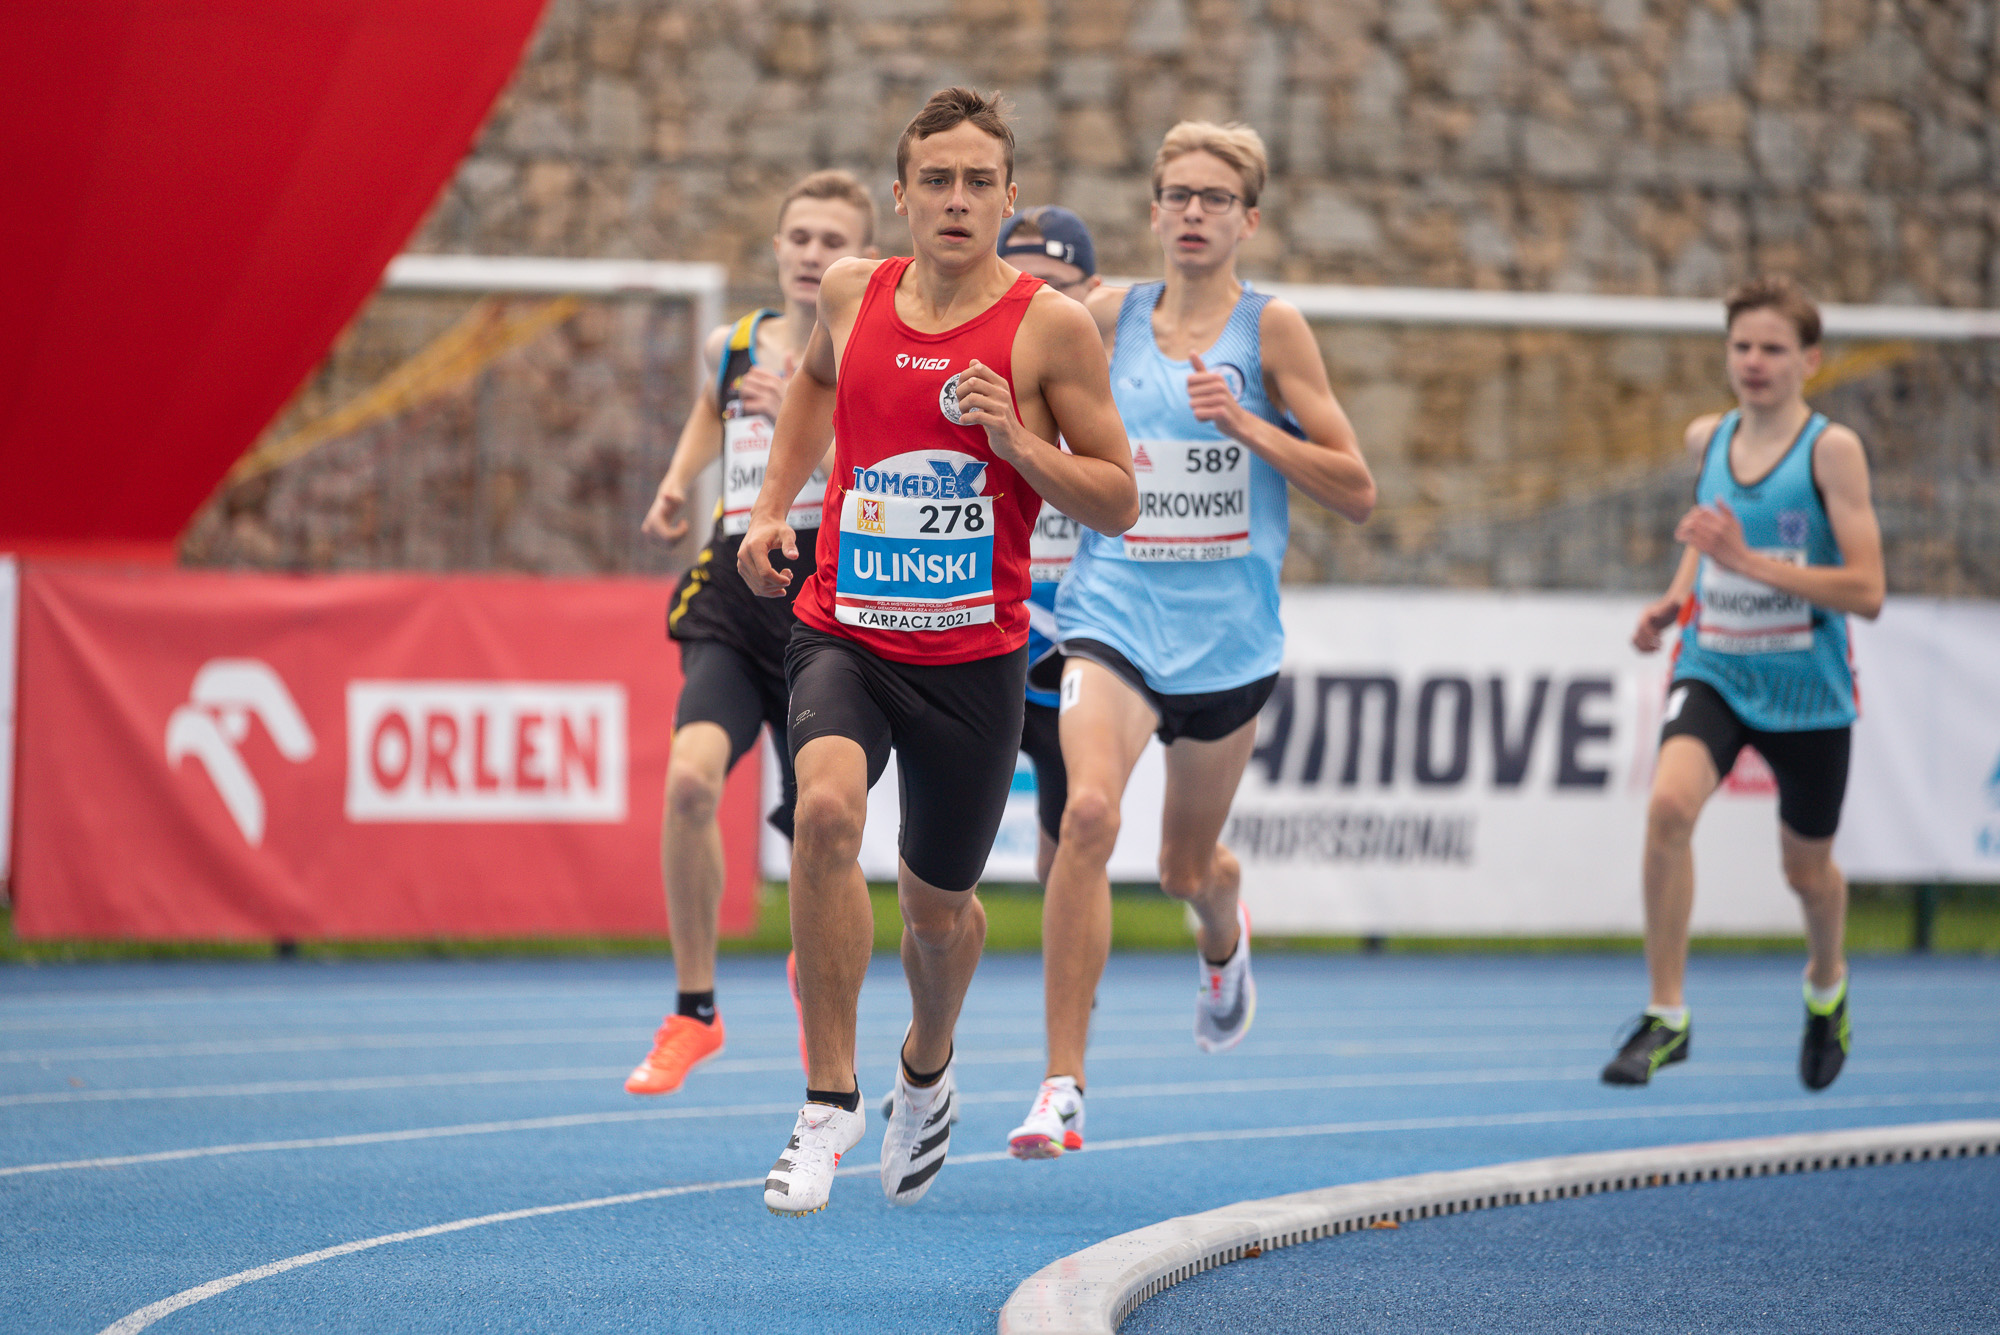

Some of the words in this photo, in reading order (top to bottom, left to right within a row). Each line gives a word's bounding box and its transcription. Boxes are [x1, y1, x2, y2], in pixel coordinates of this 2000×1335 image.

[1186, 446, 1241, 473] 589
[853, 459, 988, 499] TOMADEX
[858, 520, 884, 533] PZLA
[919, 503, 985, 533] 278
[854, 547, 977, 584] ULIŃSKI
[1131, 546, 1196, 560] KARPACZ
[859, 612, 932, 629] KARPACZ
[937, 612, 971, 628] 2021
[370, 710, 599, 793] ORLEN
